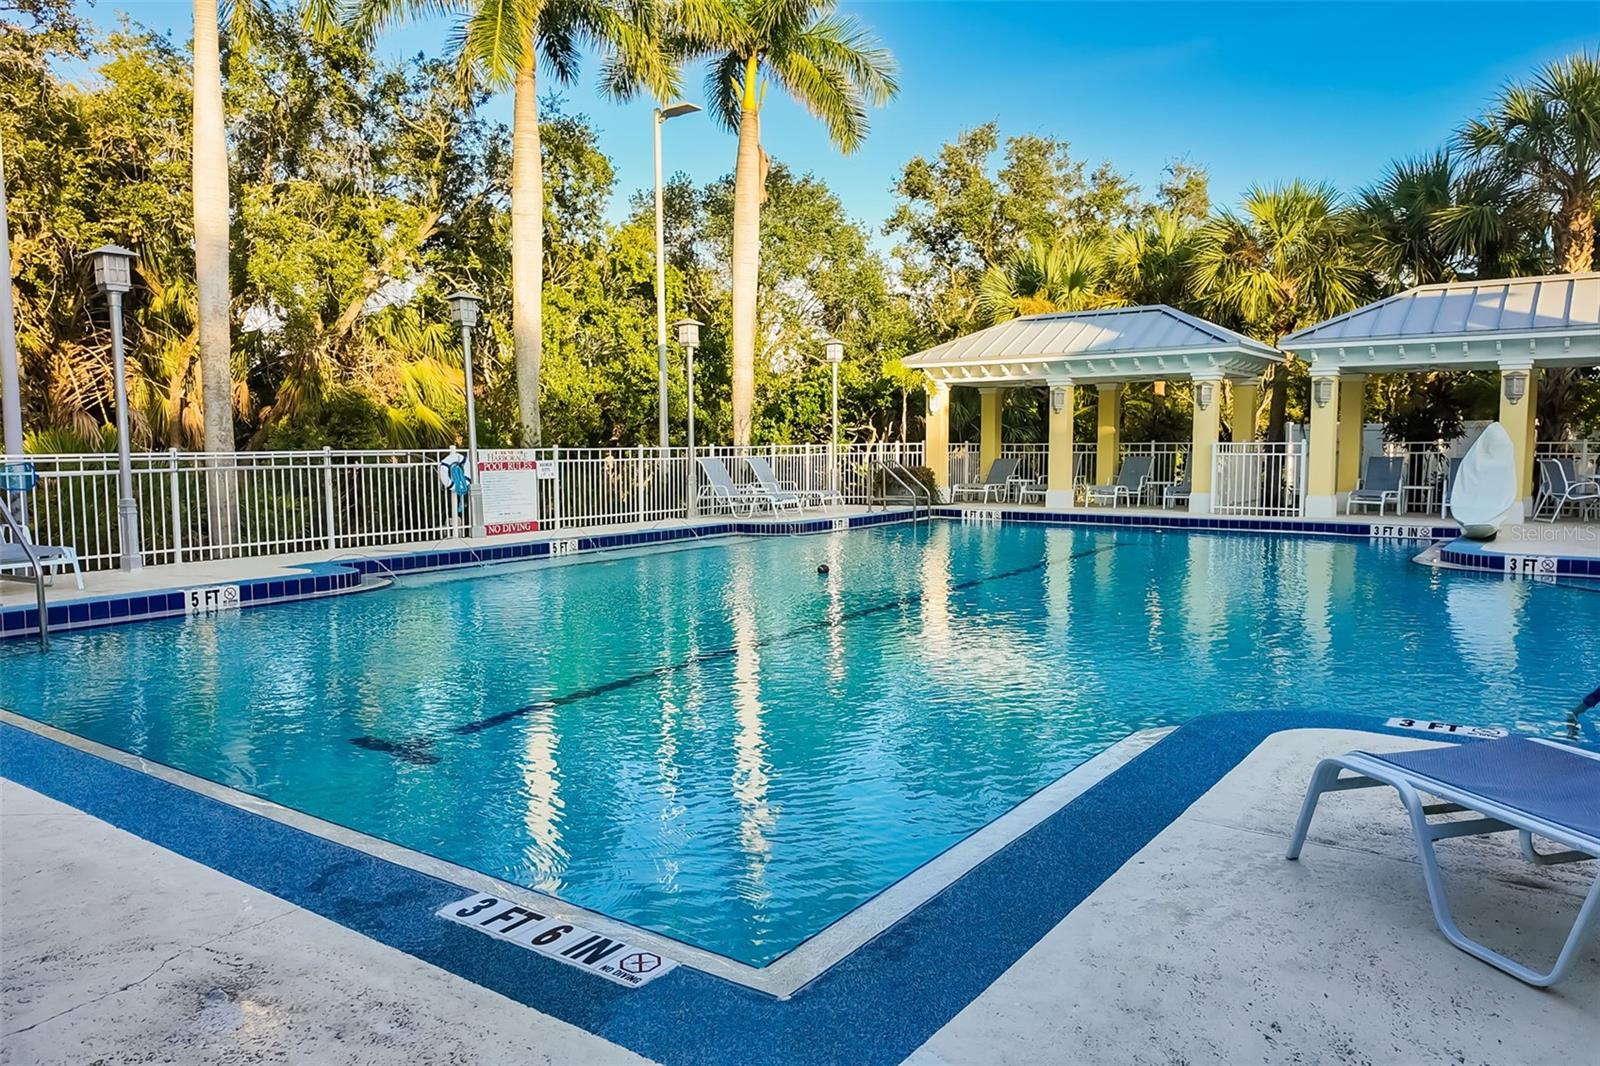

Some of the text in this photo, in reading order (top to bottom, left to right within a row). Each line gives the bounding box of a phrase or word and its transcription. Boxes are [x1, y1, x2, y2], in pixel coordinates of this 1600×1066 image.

[484, 462, 508, 471] POOL
[508, 460, 532, 471] RULES
[488, 522, 531, 534] NO DIVING
[1374, 526, 1418, 537] 3 FT 6 IN
[552, 541, 568, 554] 5 FT
[1510, 558, 1538, 573] 3 FT
[191, 591, 199, 607] 5
[205, 589, 220, 606] FT
[1399, 719, 1463, 732] 3 FT
[456, 898, 625, 966] 3 FT 6 IN
[600, 964, 643, 985] NO DIVING
